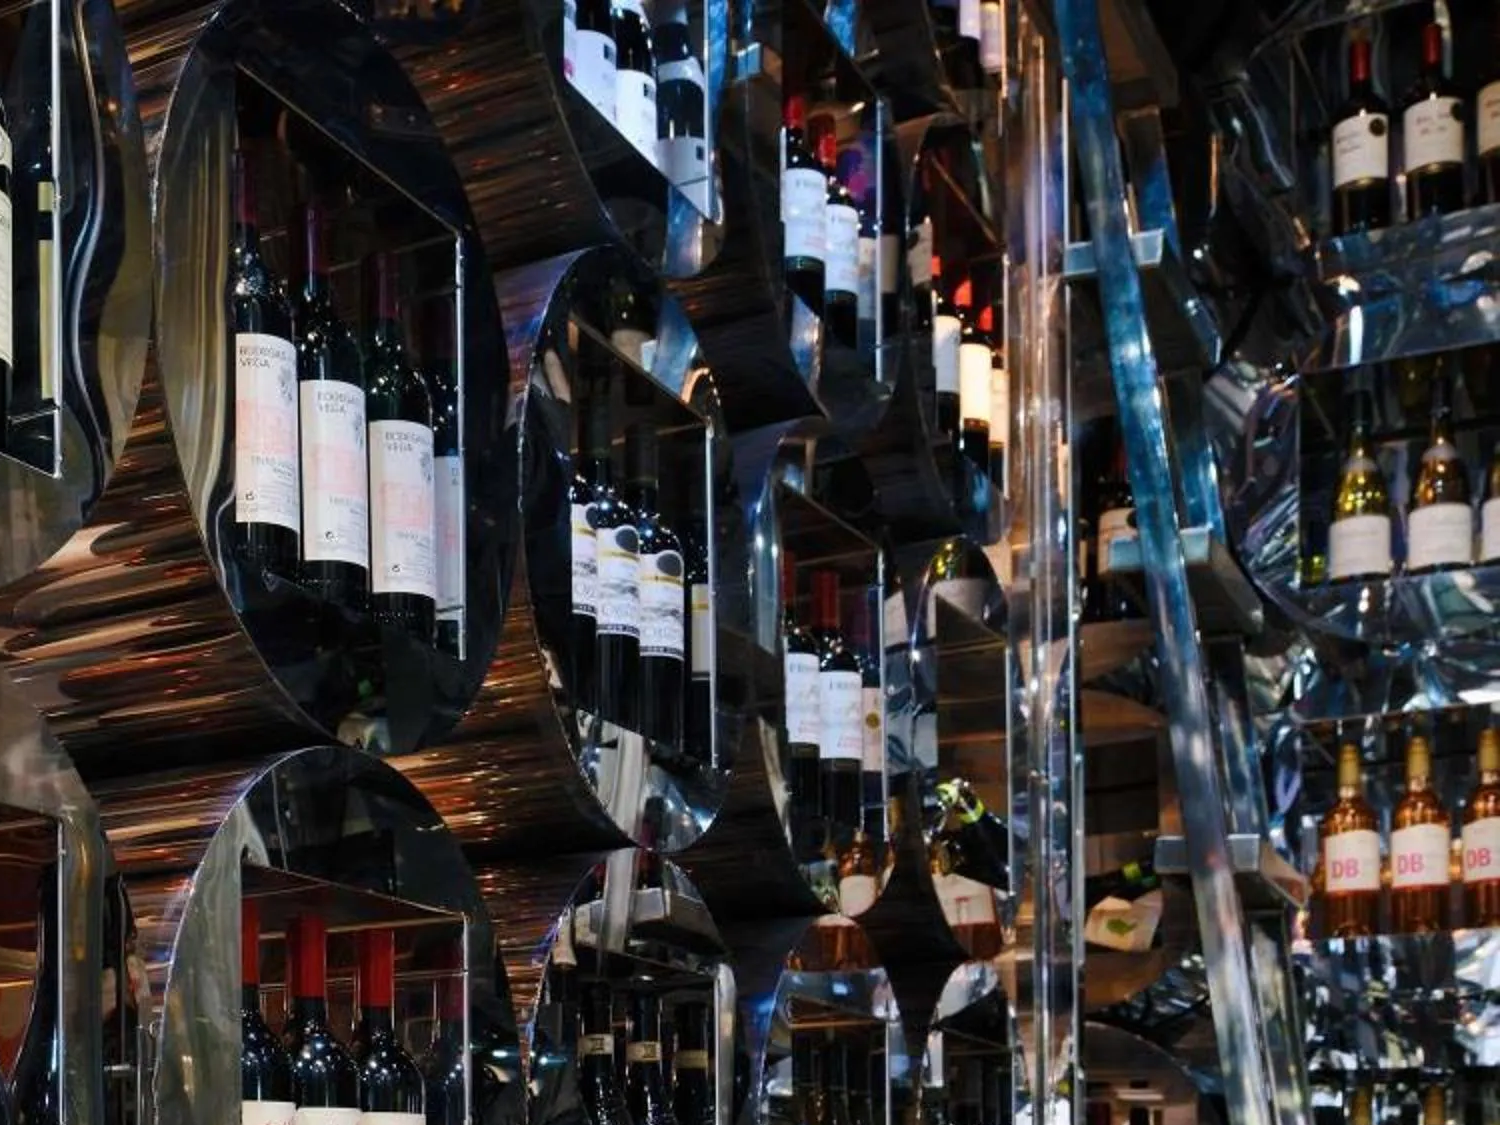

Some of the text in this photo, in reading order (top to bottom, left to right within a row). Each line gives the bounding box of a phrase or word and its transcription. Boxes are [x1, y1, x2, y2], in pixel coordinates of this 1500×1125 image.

[1397, 853, 1424, 874] DB
[1467, 848, 1491, 868] DB
[1331, 859, 1359, 878] DB
